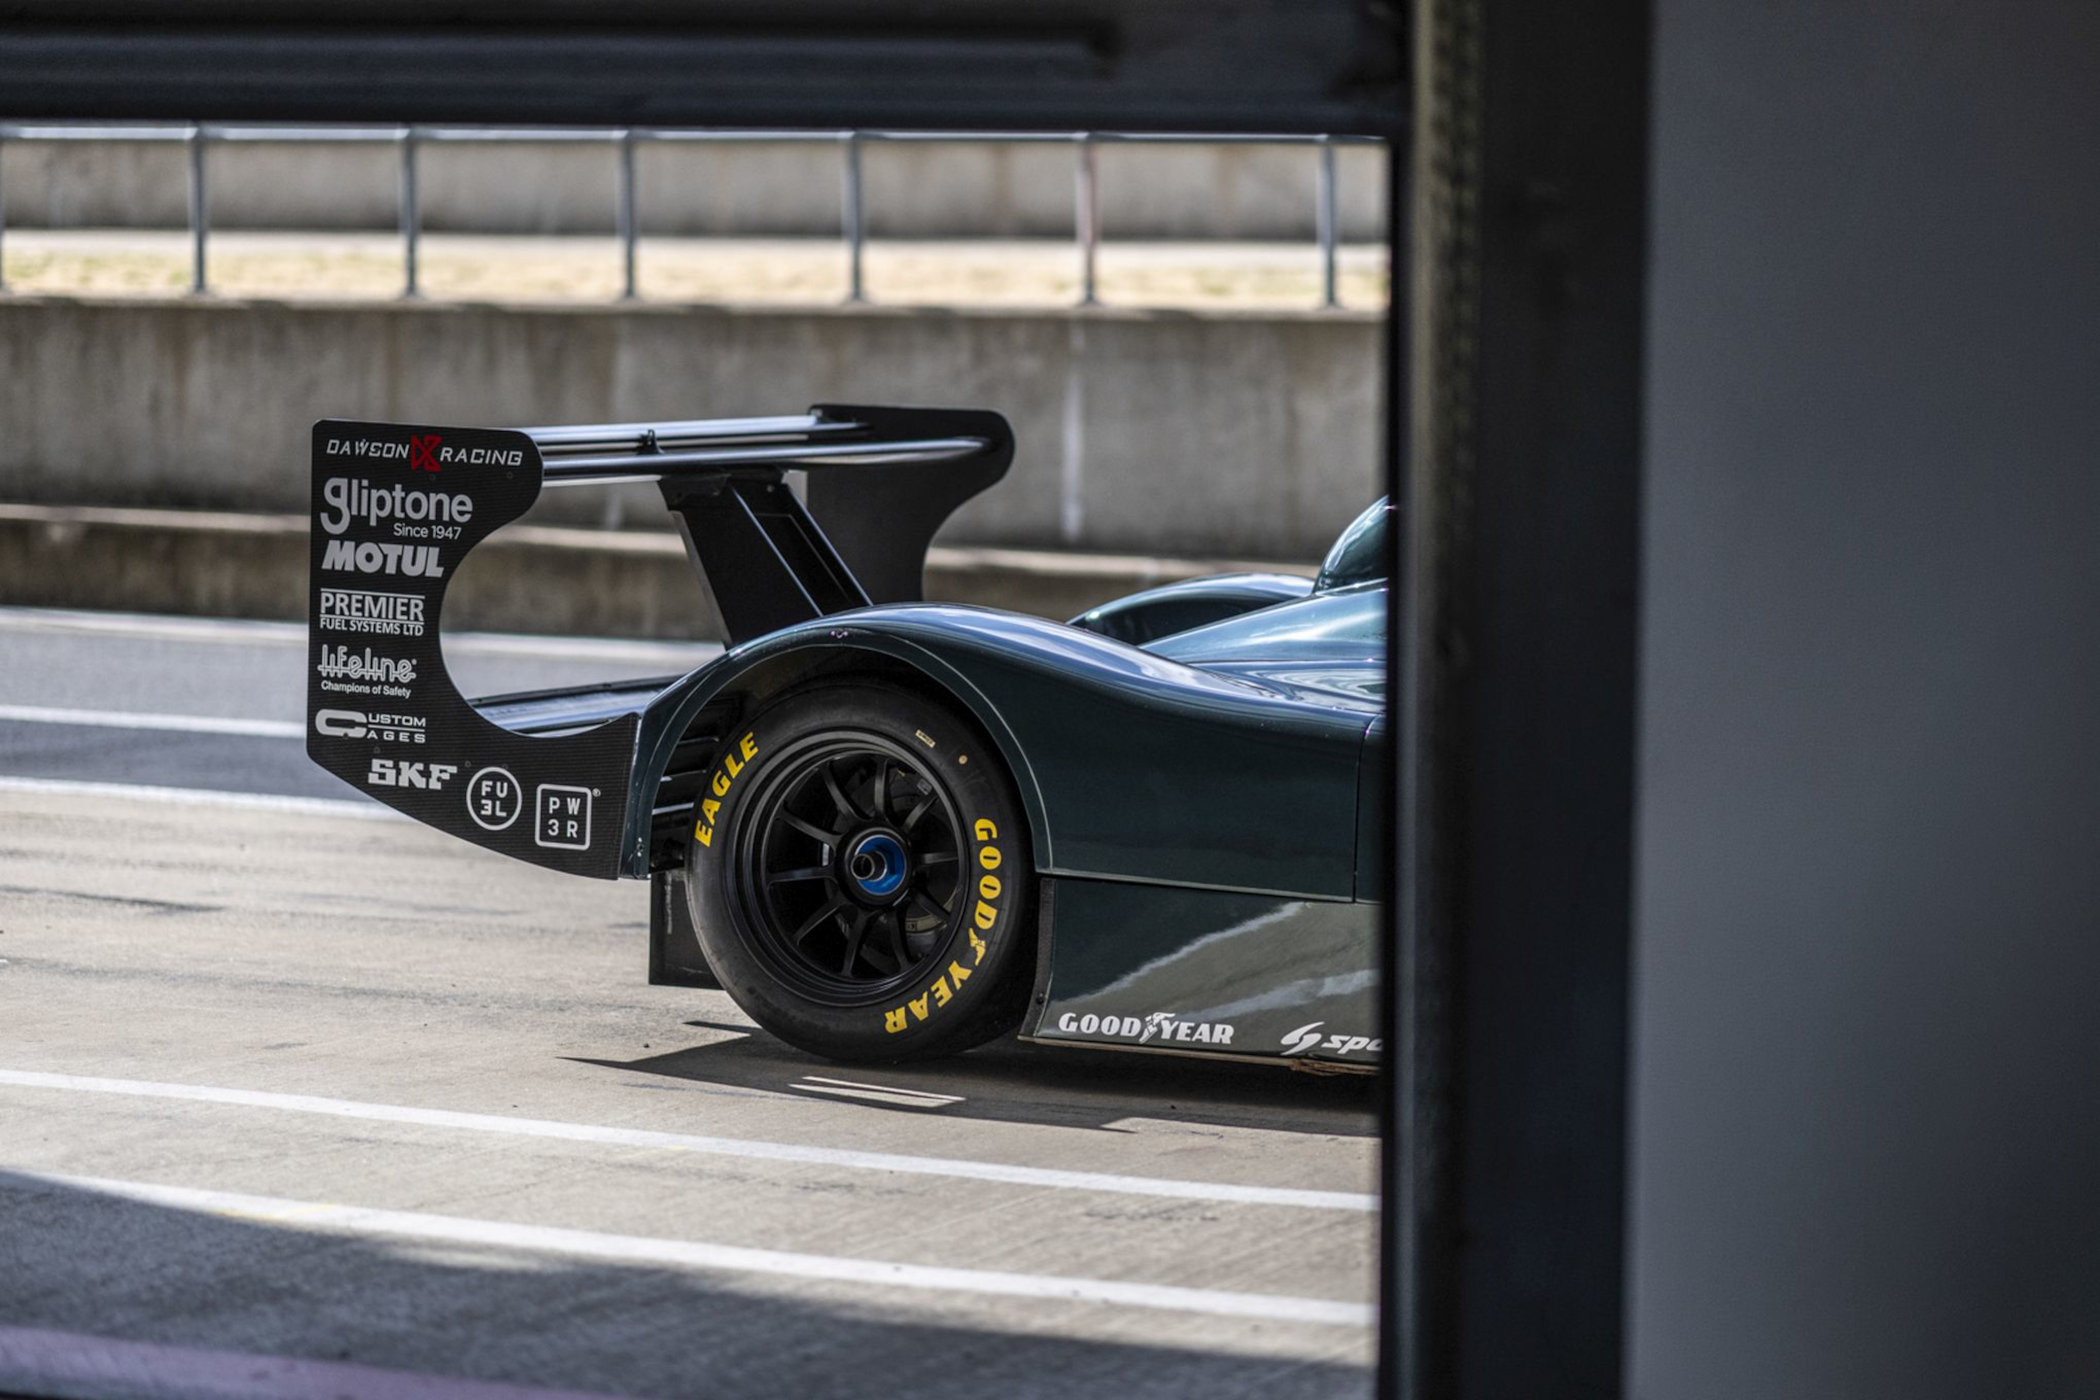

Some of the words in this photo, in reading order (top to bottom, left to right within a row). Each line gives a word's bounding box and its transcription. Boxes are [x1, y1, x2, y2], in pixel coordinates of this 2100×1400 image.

[326, 438, 409, 459] DAWSON
[440, 447, 523, 467] RACING
[320, 477, 473, 535] gliptone
[394, 522, 429, 539] Since
[432, 525, 462, 541] 1947
[322, 539, 444, 578] MOTUL
[320, 592, 424, 621] PREMIER
[320, 617, 347, 631] FUEL
[349, 620, 401, 635] SYSTEMS
[403, 624, 424, 636] LTD
[321, 680, 370, 694] Champions
[372, 685, 382, 694] of
[383, 685, 411, 699] Safety
[368, 758, 457, 790] SKF
[694, 731, 759, 848] EAGLE
